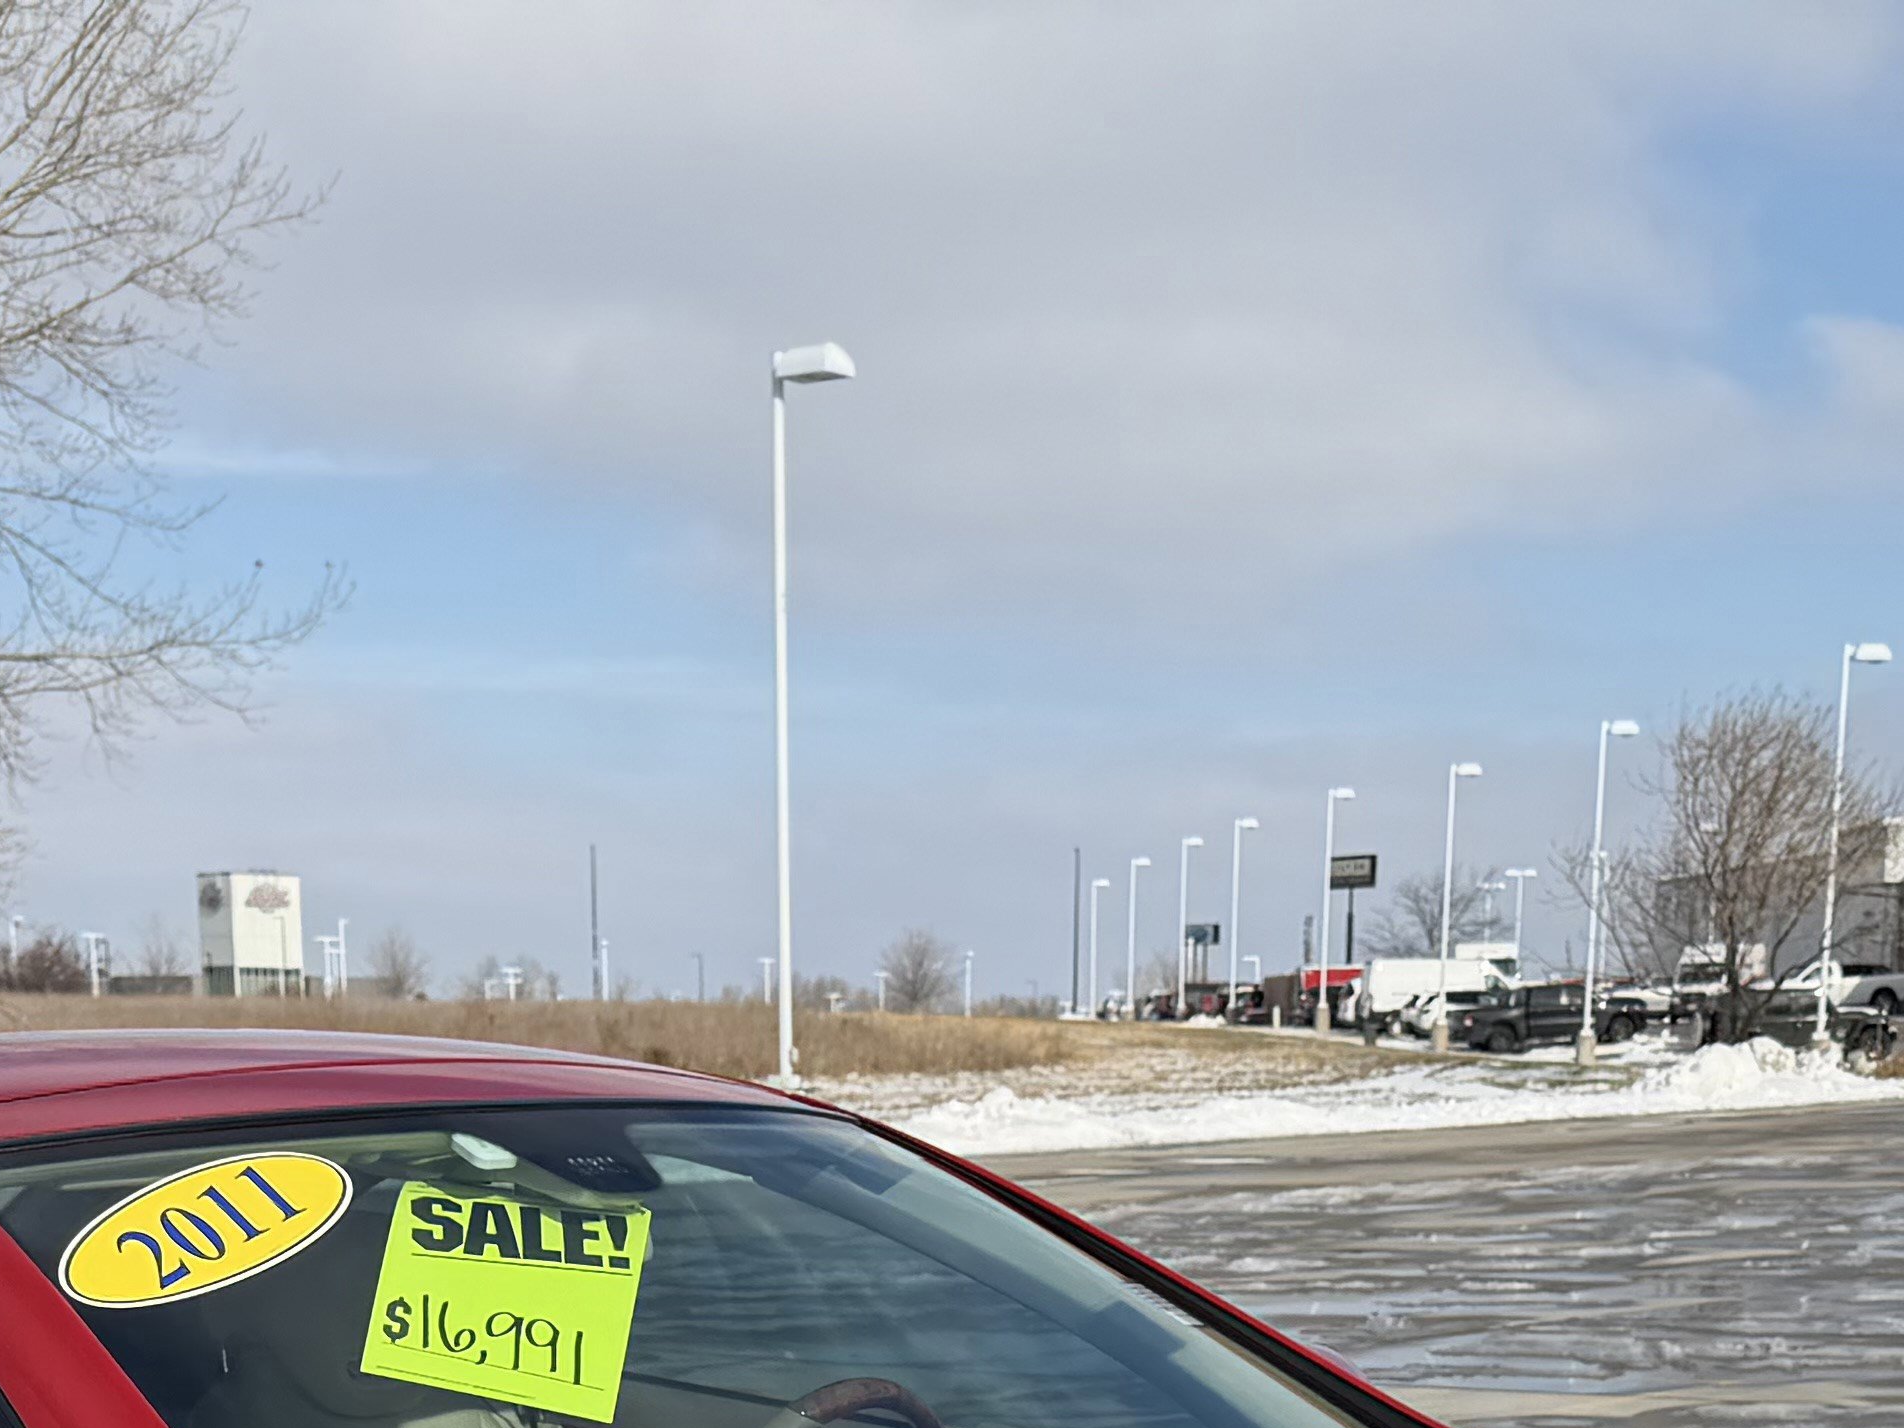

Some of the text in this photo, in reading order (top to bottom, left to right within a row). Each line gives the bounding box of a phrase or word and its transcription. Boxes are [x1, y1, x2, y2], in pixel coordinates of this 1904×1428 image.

[116, 1166, 307, 1289] 2011
[411, 1196, 631, 1270] SALE!
[382, 1294, 583, 1385] $16,991
